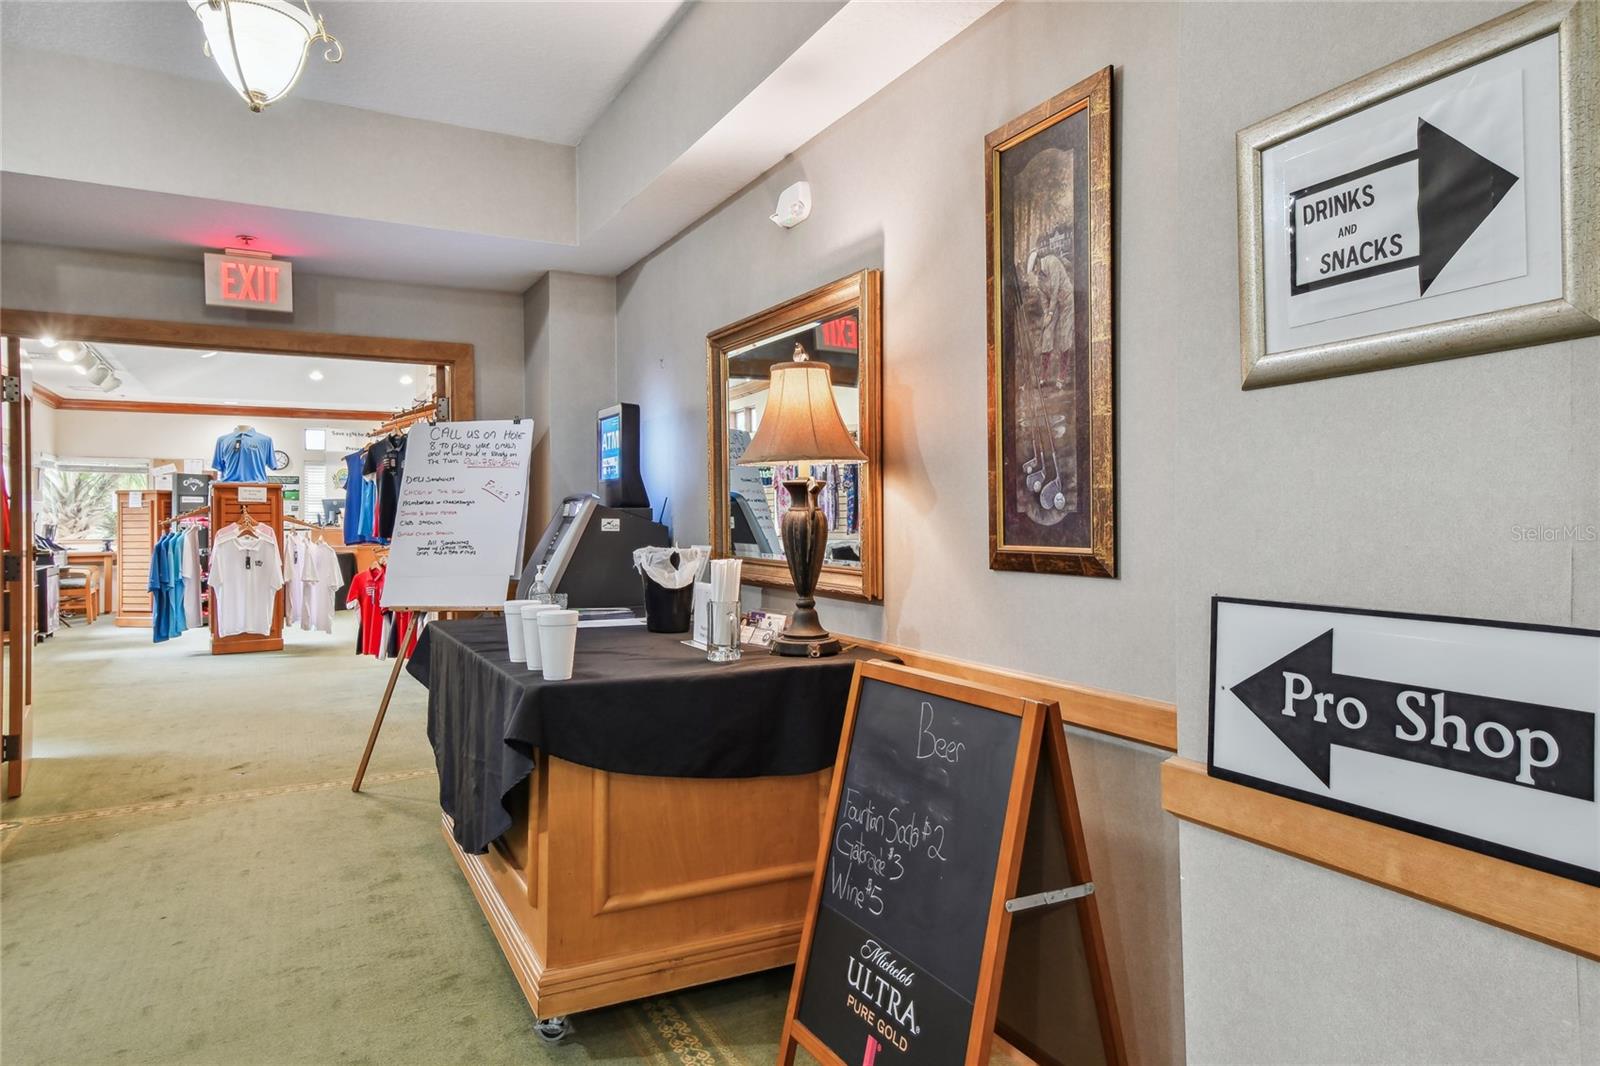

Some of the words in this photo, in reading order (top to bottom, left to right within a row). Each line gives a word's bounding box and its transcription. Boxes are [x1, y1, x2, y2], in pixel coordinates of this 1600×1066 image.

[1302, 184, 1375, 226] DRINKS
[1319, 233, 1403, 274] SNACKS
[1337, 223, 1358, 238] AND
[221, 262, 280, 304] EXIT
[916, 702, 966, 762] Beer
[1281, 671, 1368, 730] Pro
[1395, 689, 1560, 785] Shop
[885, 807, 920, 851] Soda
[831, 855, 865, 909] Wine
[865, 878, 885, 916] $5
[860, 939, 915, 987] Michelob
[847, 955, 918, 1035] ULTRA
[846, 994, 876, 1026] PURE
[876, 1019, 909, 1052] GOLD
